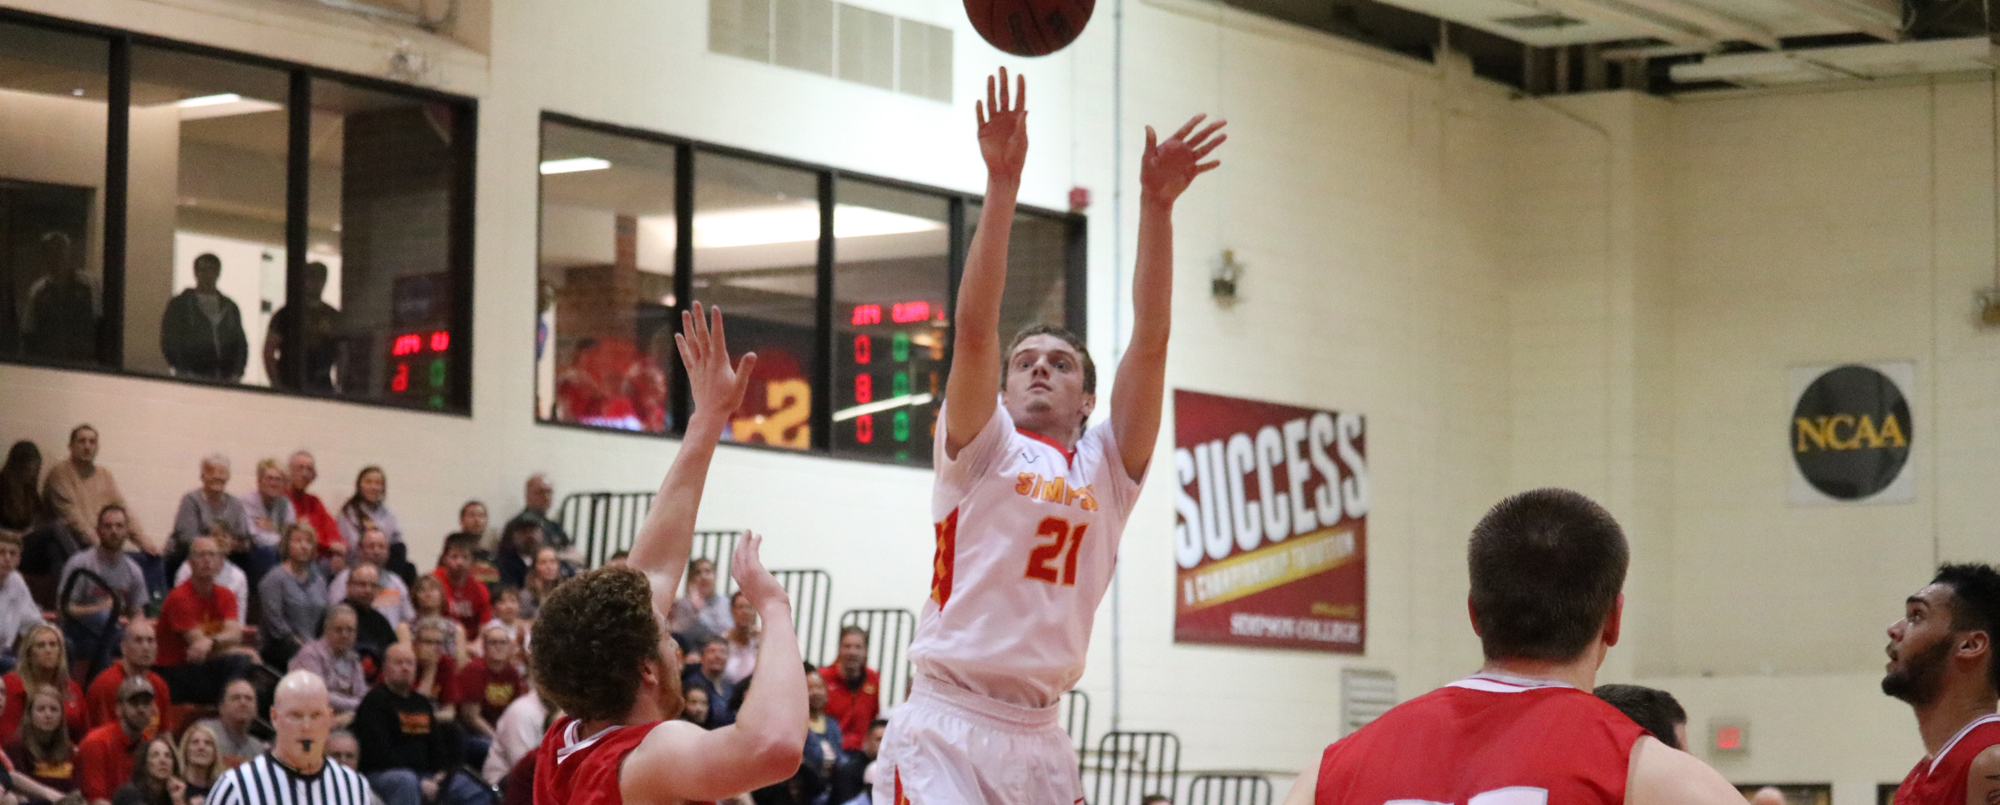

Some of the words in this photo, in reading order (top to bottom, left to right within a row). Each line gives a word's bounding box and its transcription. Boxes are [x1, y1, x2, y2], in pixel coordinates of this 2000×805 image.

[1796, 414, 1906, 452] NCAA
[1175, 412, 1371, 569] SUCCESS
[1025, 515, 1089, 587] 21
